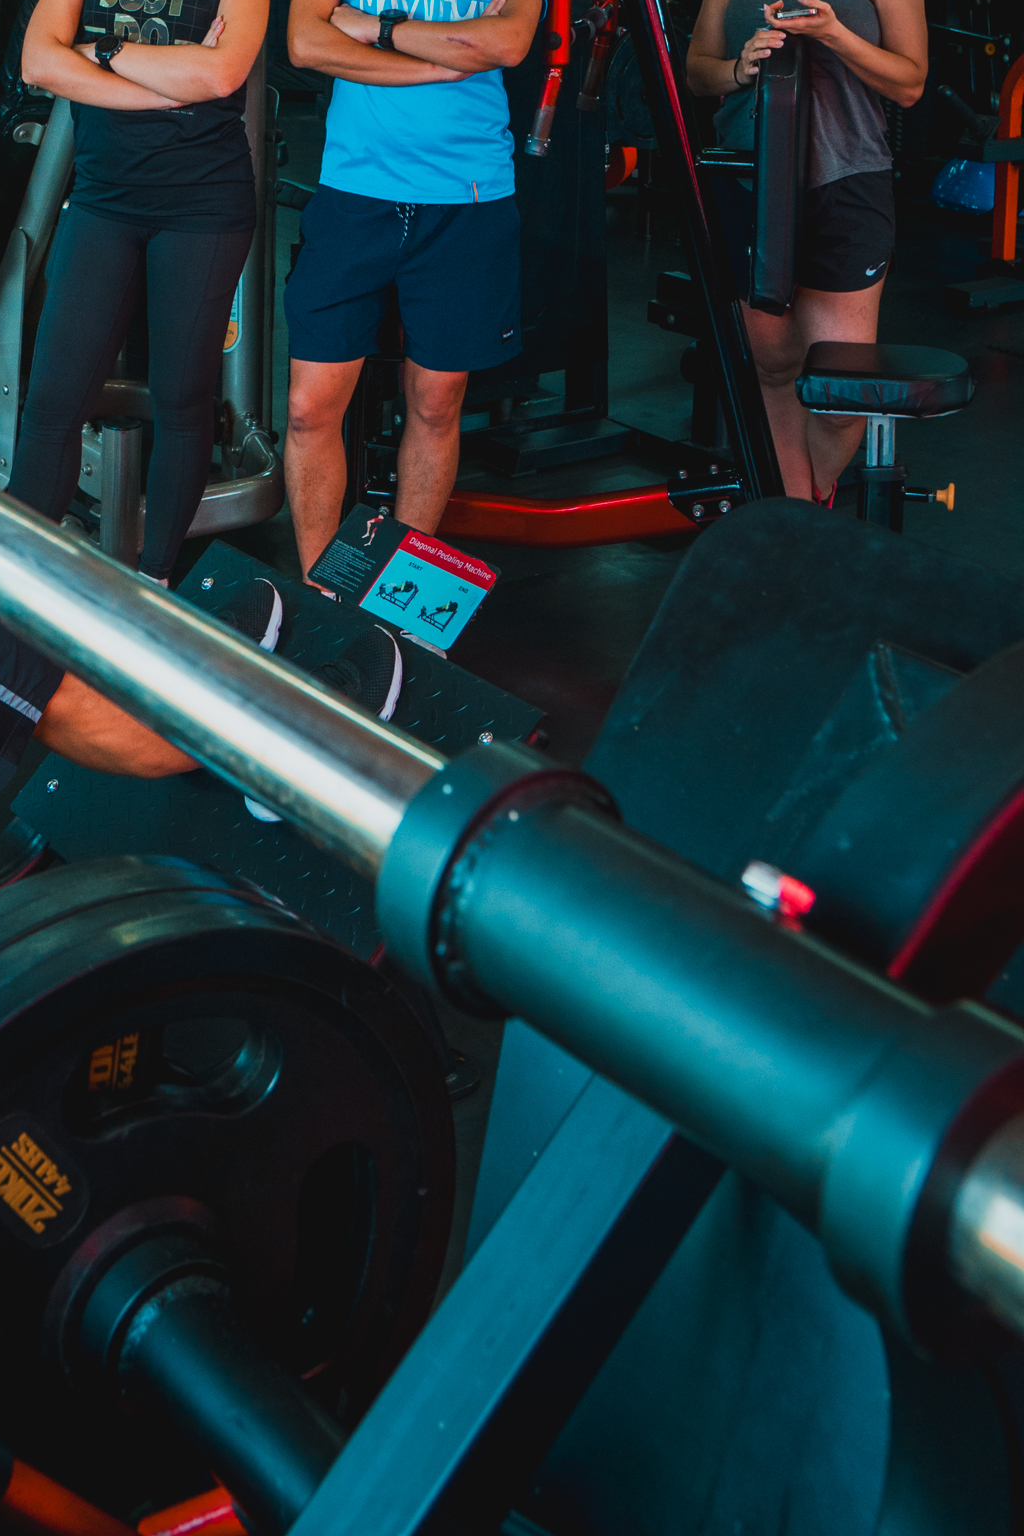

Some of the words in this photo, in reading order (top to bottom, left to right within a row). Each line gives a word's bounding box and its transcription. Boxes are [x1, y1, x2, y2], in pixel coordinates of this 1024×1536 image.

[114, 13, 170, 46] DO
[408, 561, 424, 572] START
[409, 536, 437, 555] Diagonal
[436, 549, 464, 569] Pedaling
[464, 562, 492, 581] Machine
[458, 585, 469, 594] END
[11, 1132, 72, 1196] 44LBS
